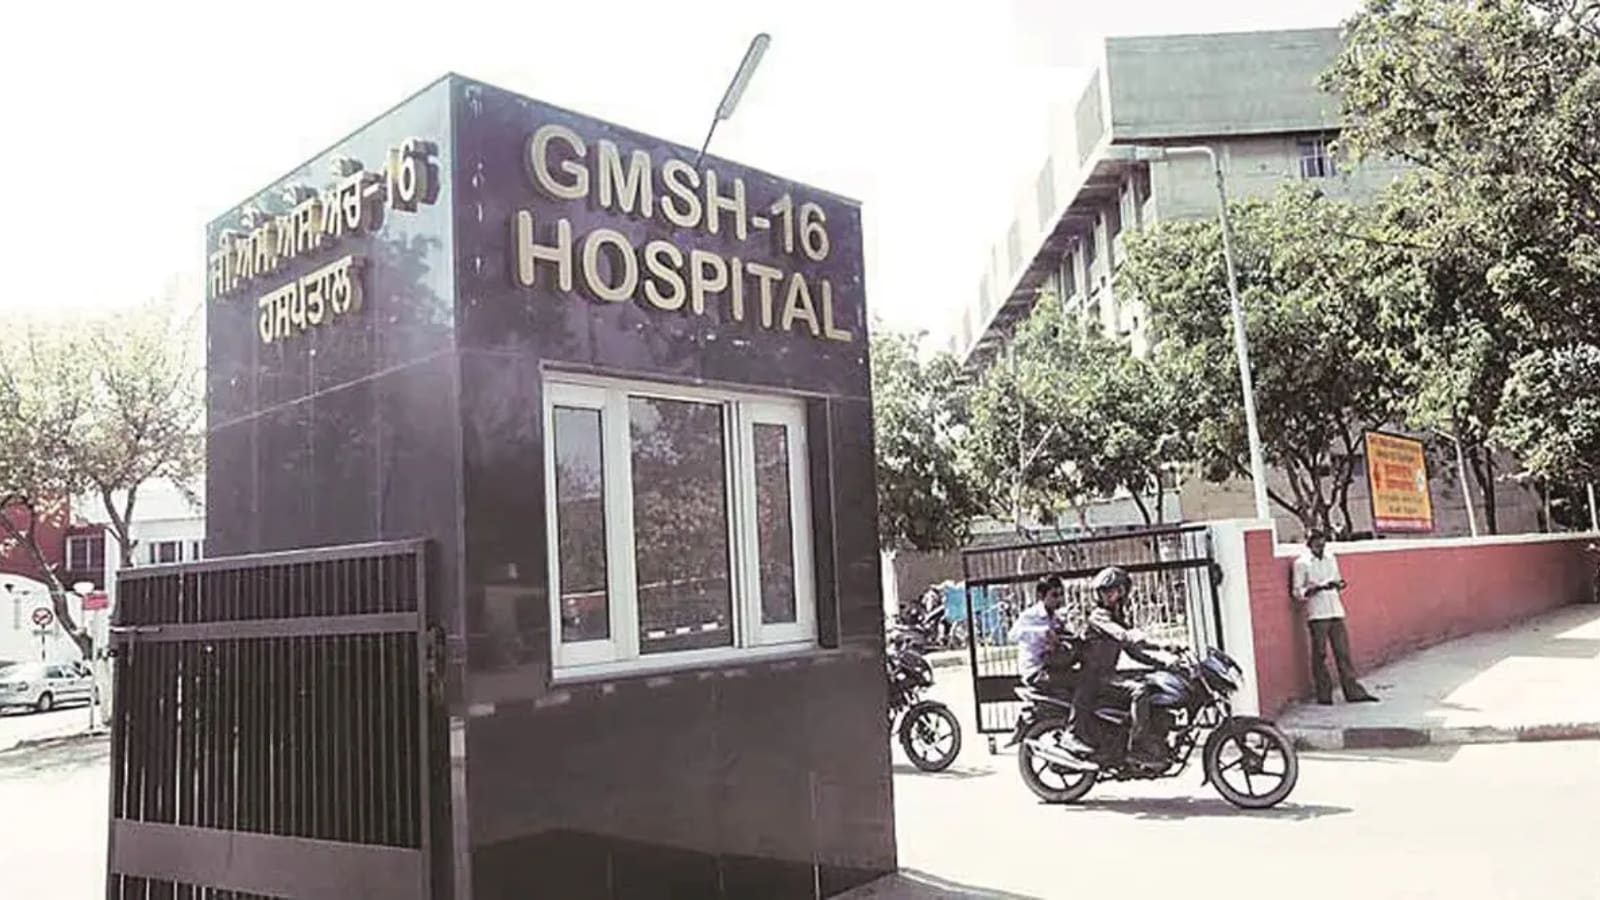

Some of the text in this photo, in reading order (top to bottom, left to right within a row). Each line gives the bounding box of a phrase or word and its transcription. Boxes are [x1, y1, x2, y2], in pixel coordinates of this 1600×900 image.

[531, 124, 830, 261] GMSH-16
[258, 254, 353, 344] ਹਸਪਤਾਲ
[517, 209, 853, 342] HOSPITAL
